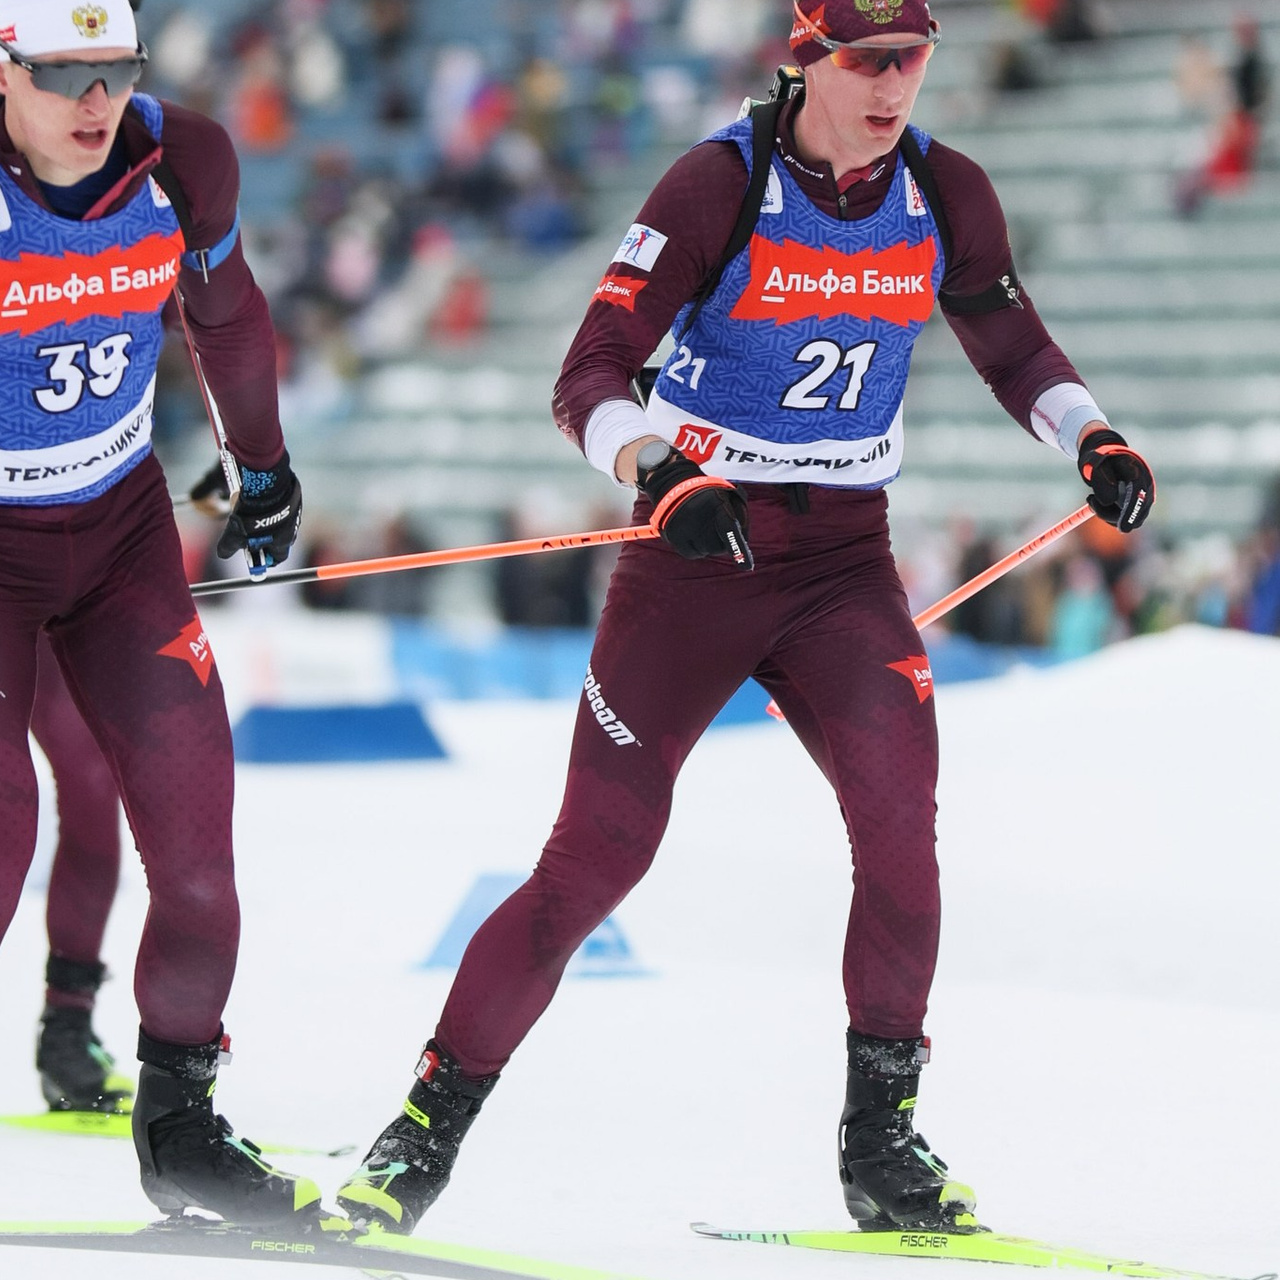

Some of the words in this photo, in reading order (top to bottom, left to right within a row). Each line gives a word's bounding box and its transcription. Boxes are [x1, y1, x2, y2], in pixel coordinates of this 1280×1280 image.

[1, 272, 104, 317] Альфа
[111, 258, 176, 294] Банк
[605, 281, 632, 297] Банк
[761, 266, 857, 303] Альфа
[863, 270, 924, 294] Банк
[33, 333, 132, 413] 39
[667, 346, 706, 390] 21
[781, 340, 877, 409] 21
[254, 505, 290, 530] SWIX
[251, 1241, 315, 1254] FISCHER
[900, 1235, 948, 1248] FISCHER
